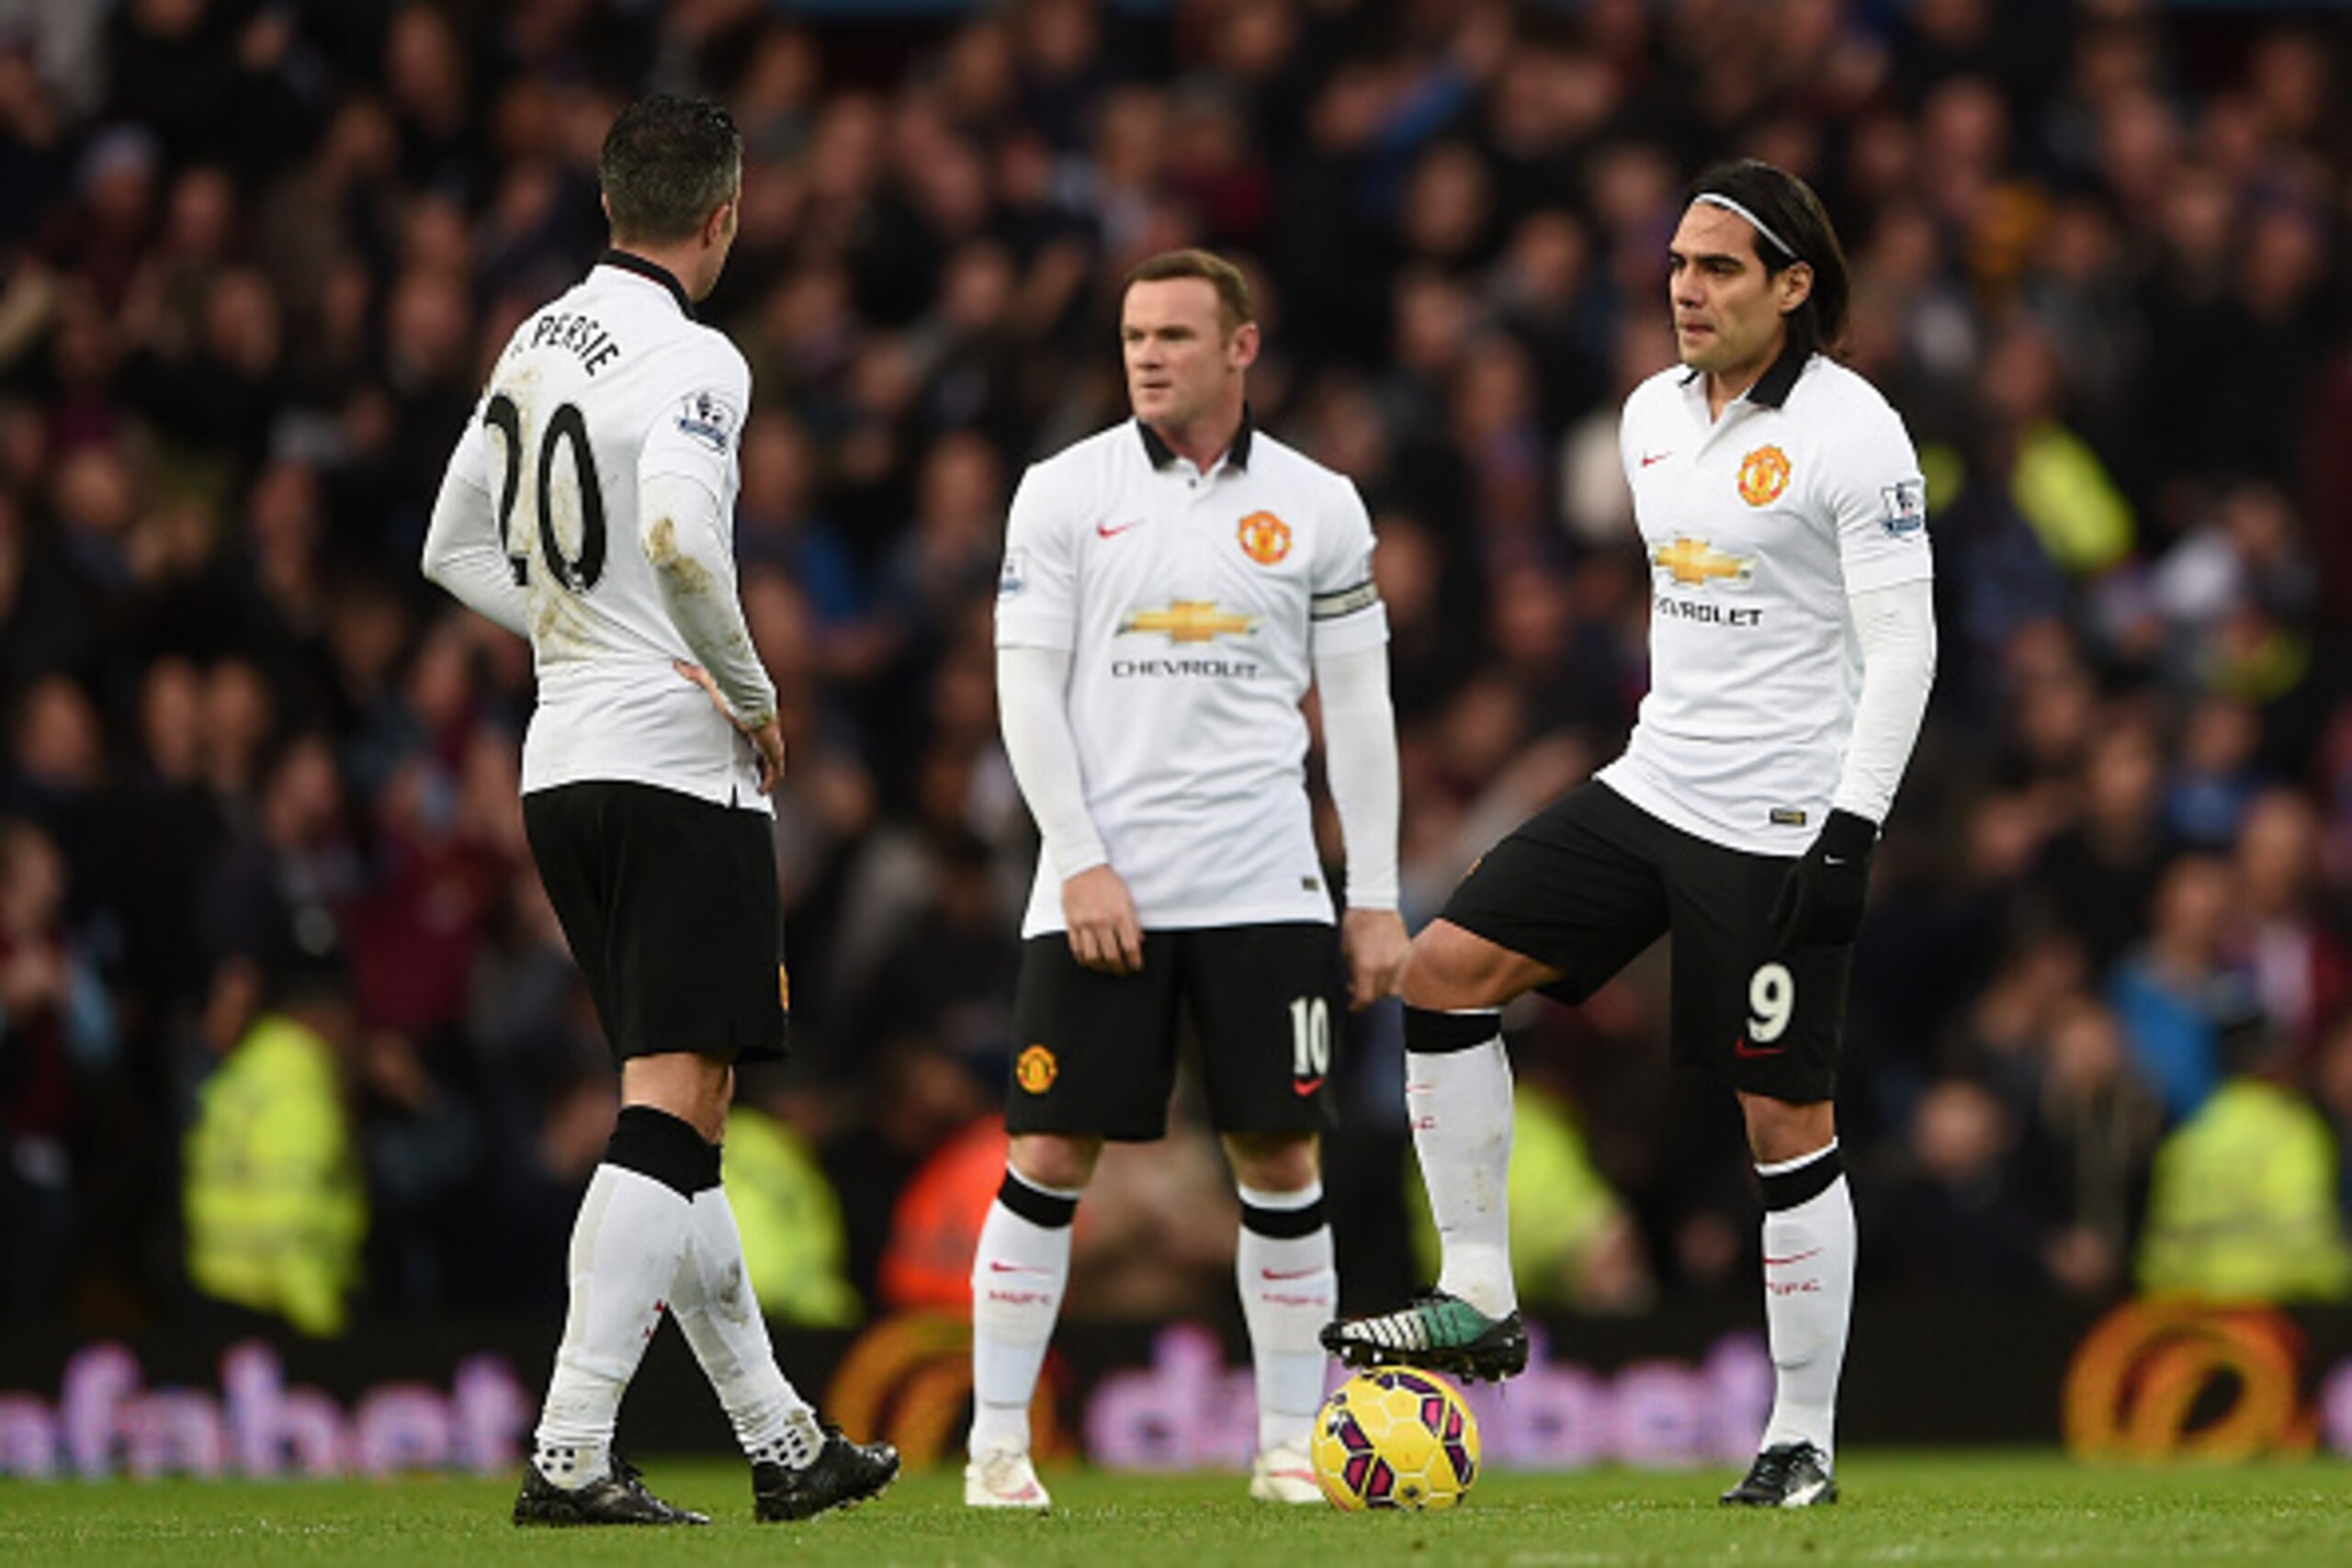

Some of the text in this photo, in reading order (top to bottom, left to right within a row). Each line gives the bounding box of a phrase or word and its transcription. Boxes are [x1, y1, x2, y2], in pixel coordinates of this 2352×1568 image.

[530, 312, 620, 378] PERSIE
[481, 393, 607, 594] 20
[1111, 659, 1260, 681] CHEVROLET
[1290, 997, 1329, 1076] 10
[1748, 962, 1795, 1043] 9
